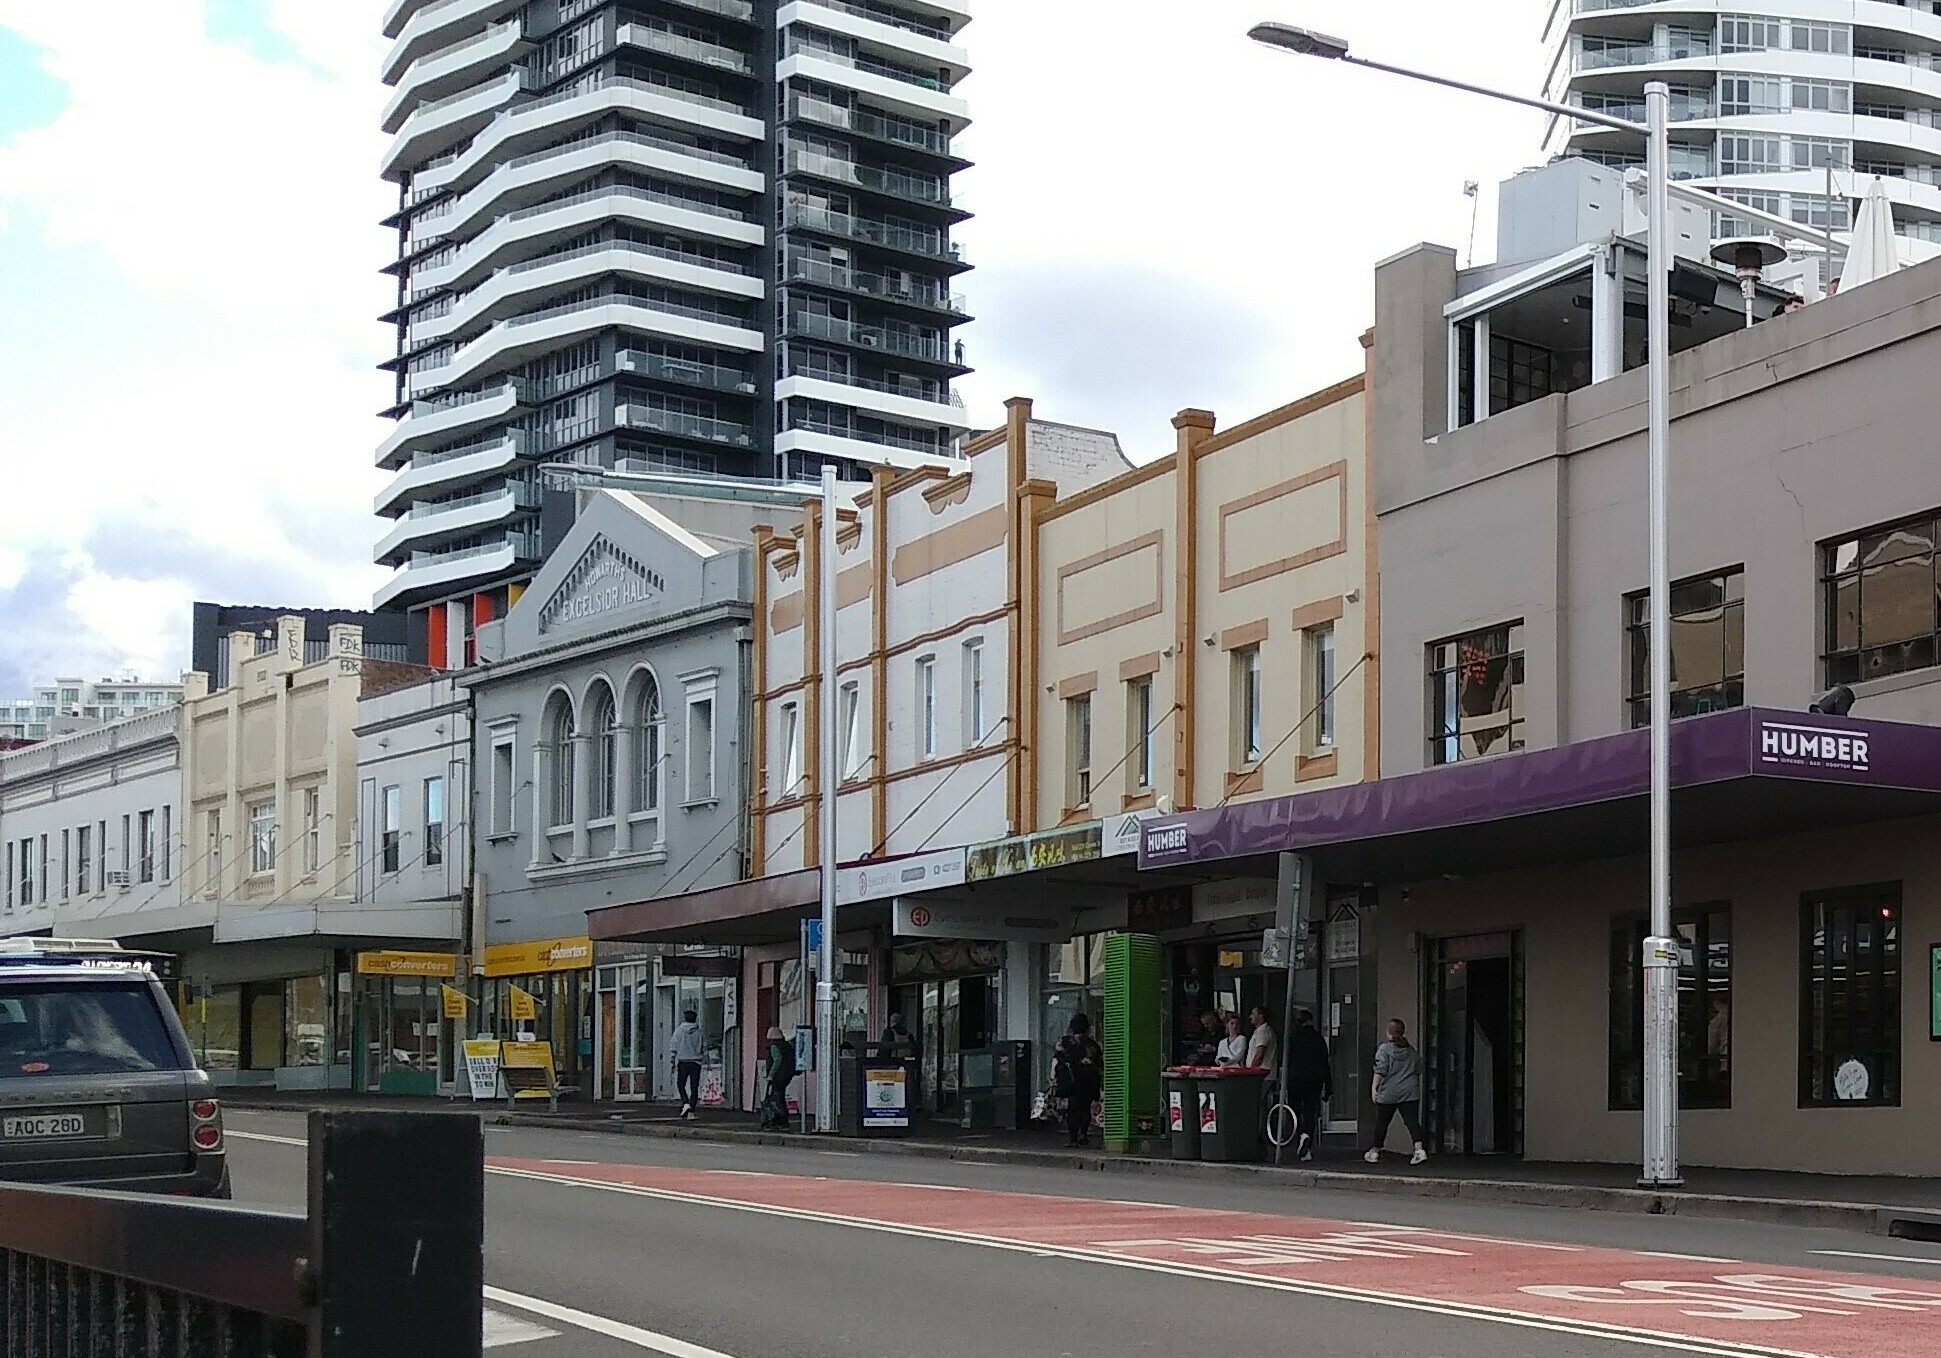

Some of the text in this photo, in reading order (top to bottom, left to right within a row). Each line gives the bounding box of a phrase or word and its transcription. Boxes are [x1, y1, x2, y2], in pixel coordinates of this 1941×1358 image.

[562, 579, 650, 621] EXCELSIOR HALL
[1762, 730, 1869, 763] HUMBER
[1147, 829, 1187, 852] HUMBER
